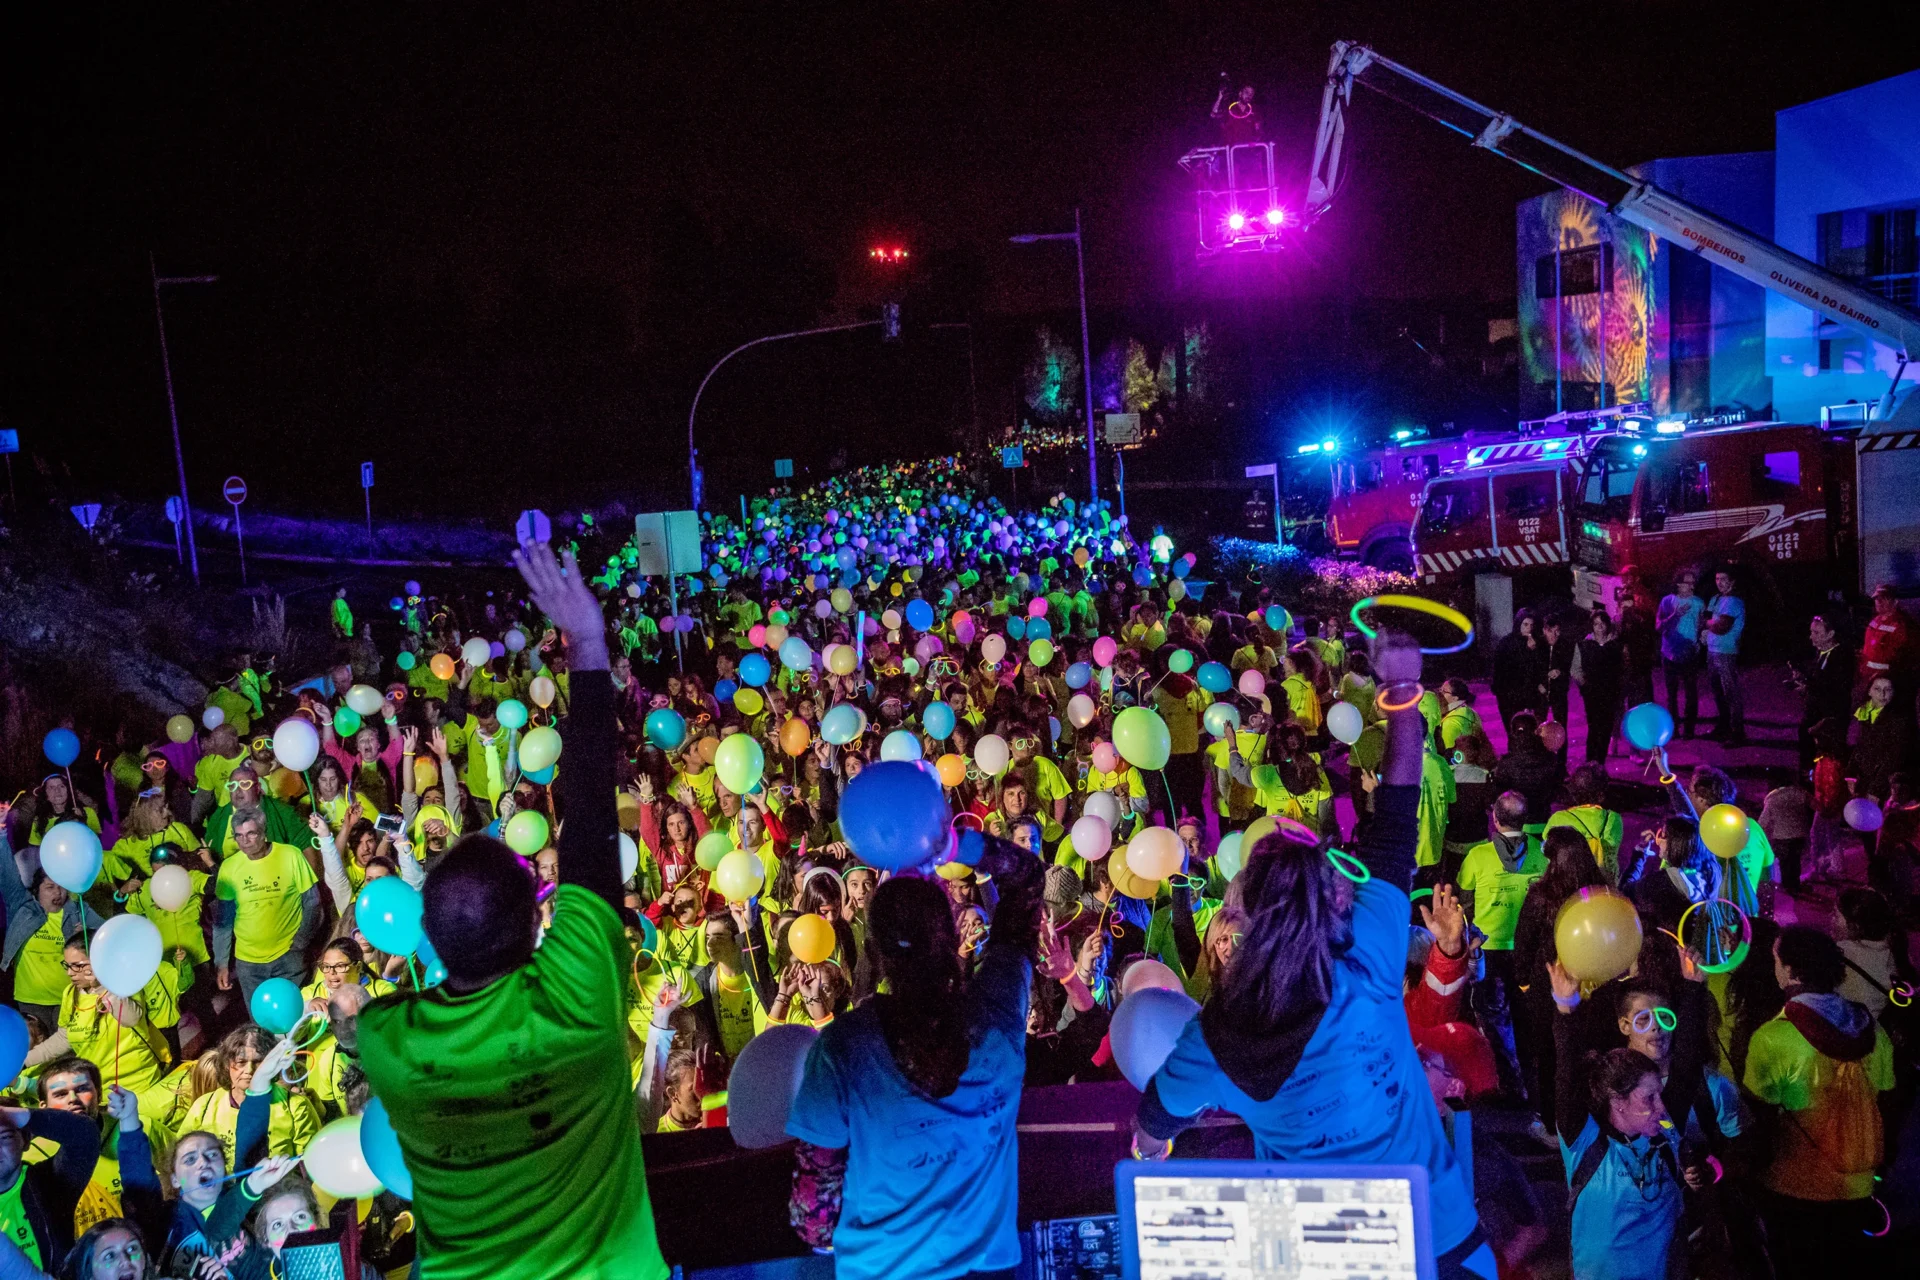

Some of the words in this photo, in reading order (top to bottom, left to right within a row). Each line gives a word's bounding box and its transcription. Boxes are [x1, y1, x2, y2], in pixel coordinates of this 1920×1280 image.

[1681, 227, 1746, 264] BOMBEIROS
[1769, 270, 1819, 301] OLIVEIRA
[1821, 295, 1838, 309] DO
[1838, 304, 1880, 329] BAIRRO
[1518, 517, 1540, 526] 0122
[1518, 525, 1540, 534] VSAT
[1524, 534, 1536, 542] 01
[1768, 532, 1800, 543] 0122
[1777, 551, 1792, 560] 06
